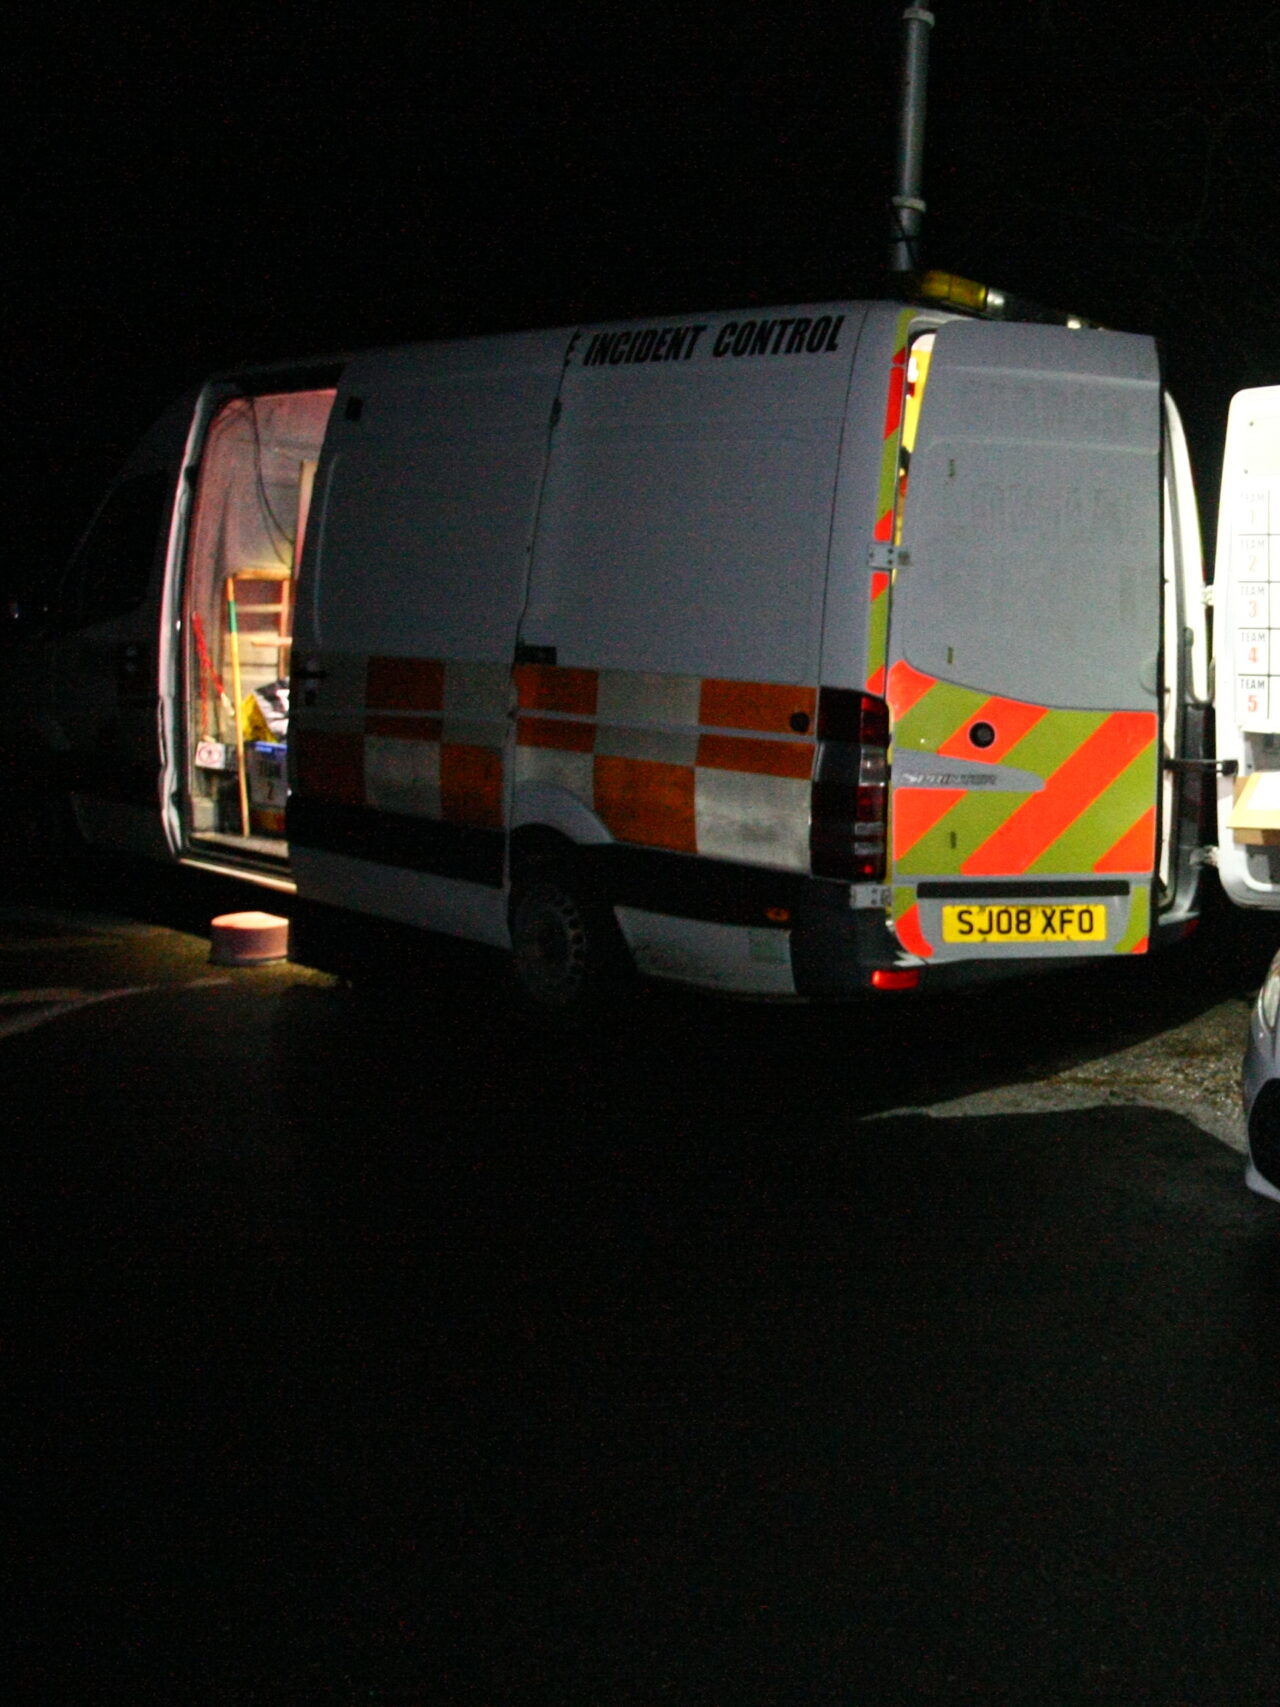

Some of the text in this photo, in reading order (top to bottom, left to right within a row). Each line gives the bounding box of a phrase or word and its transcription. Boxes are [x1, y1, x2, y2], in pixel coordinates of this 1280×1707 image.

[582, 325, 707, 366] INCIDENT
[711, 315, 846, 358] CONTROL
[1240, 586, 1266, 597] TEAM
[1248, 601, 1258, 618] 3
[1241, 632, 1266, 643] TEAM
[1248, 647, 1259, 664] 4
[1240, 679, 1266, 690] TEAM
[1247, 694, 1258, 713] 5
[957, 909, 1031, 936] SJ08
